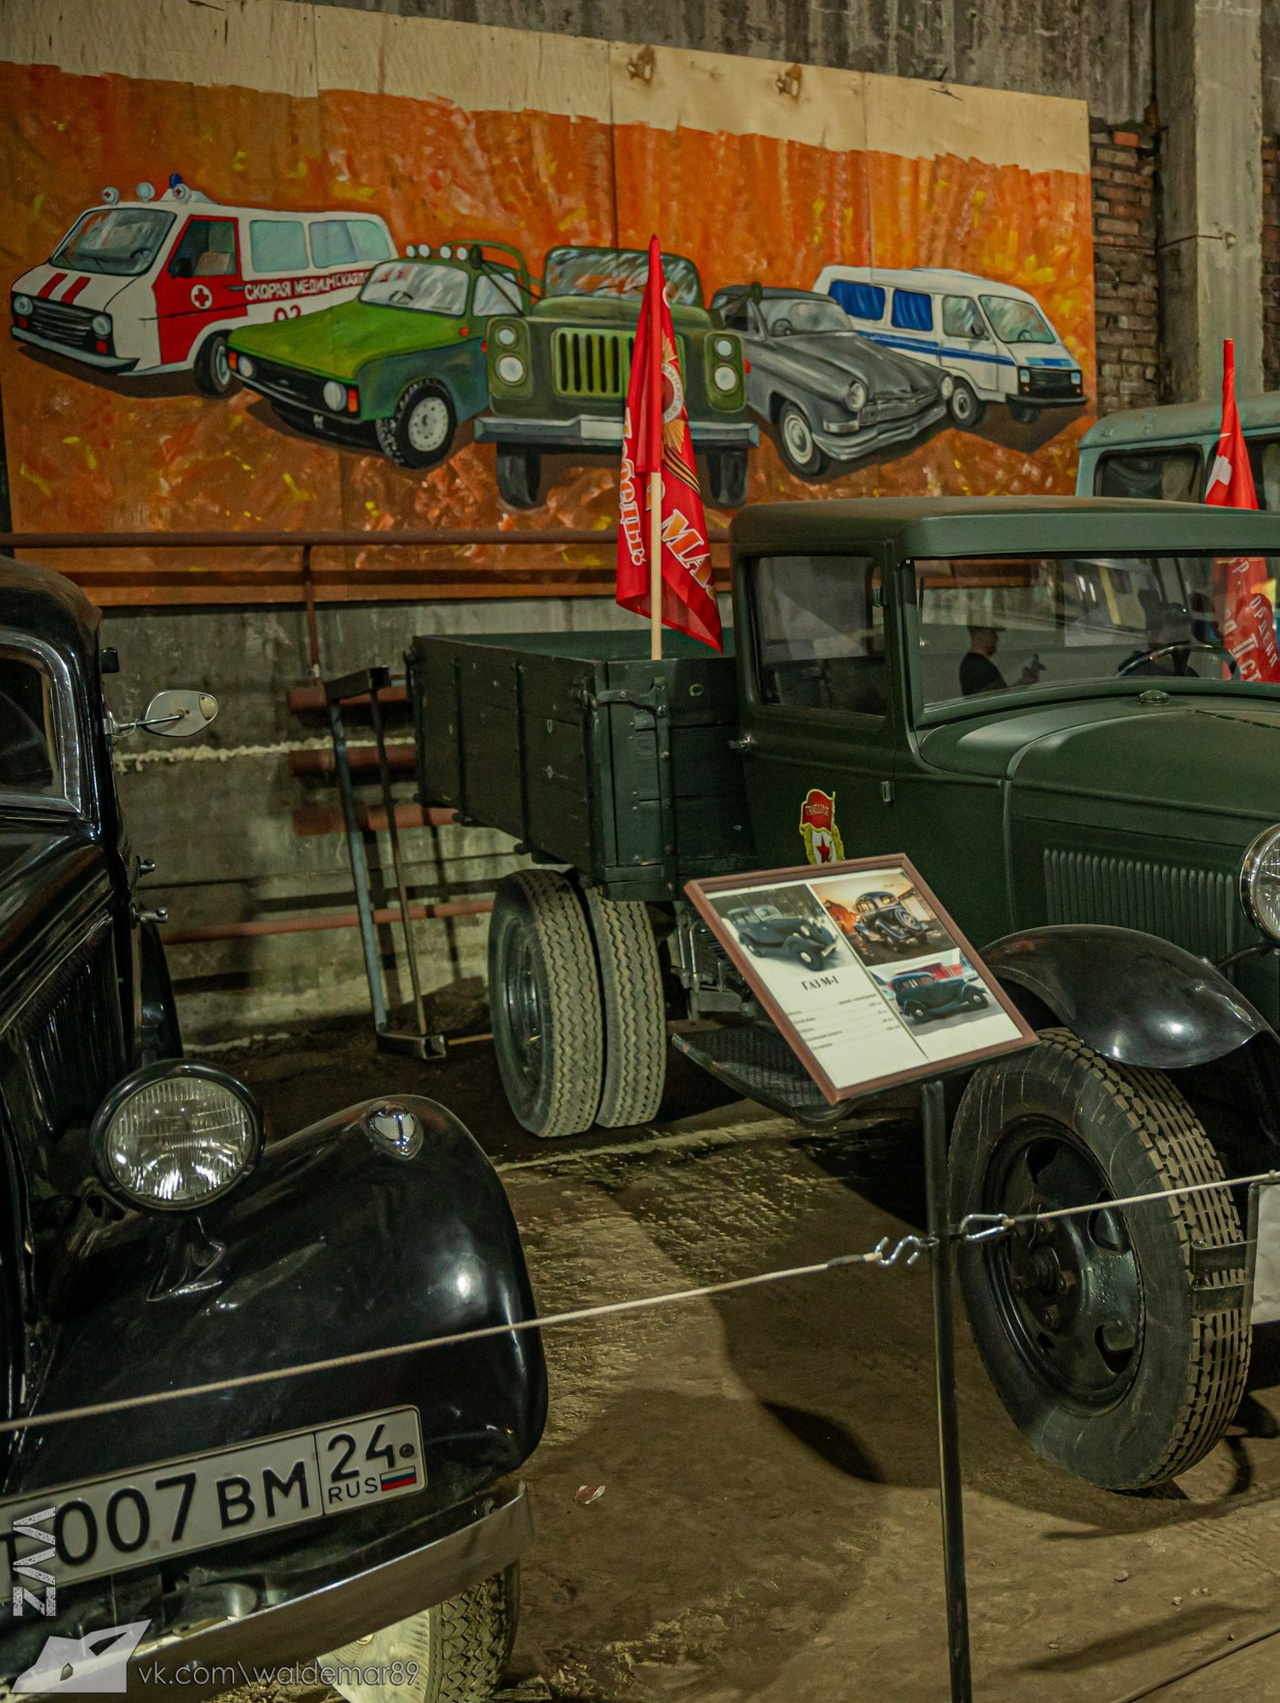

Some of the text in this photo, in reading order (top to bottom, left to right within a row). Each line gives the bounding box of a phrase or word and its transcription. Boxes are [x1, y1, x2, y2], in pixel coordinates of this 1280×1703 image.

[244, 281, 291, 300] СКОРАЯ
[801, 977, 821, 991] ГАЗ
[326, 1424, 396, 1482] 24
[328, 1476, 378, 1505] RUS
